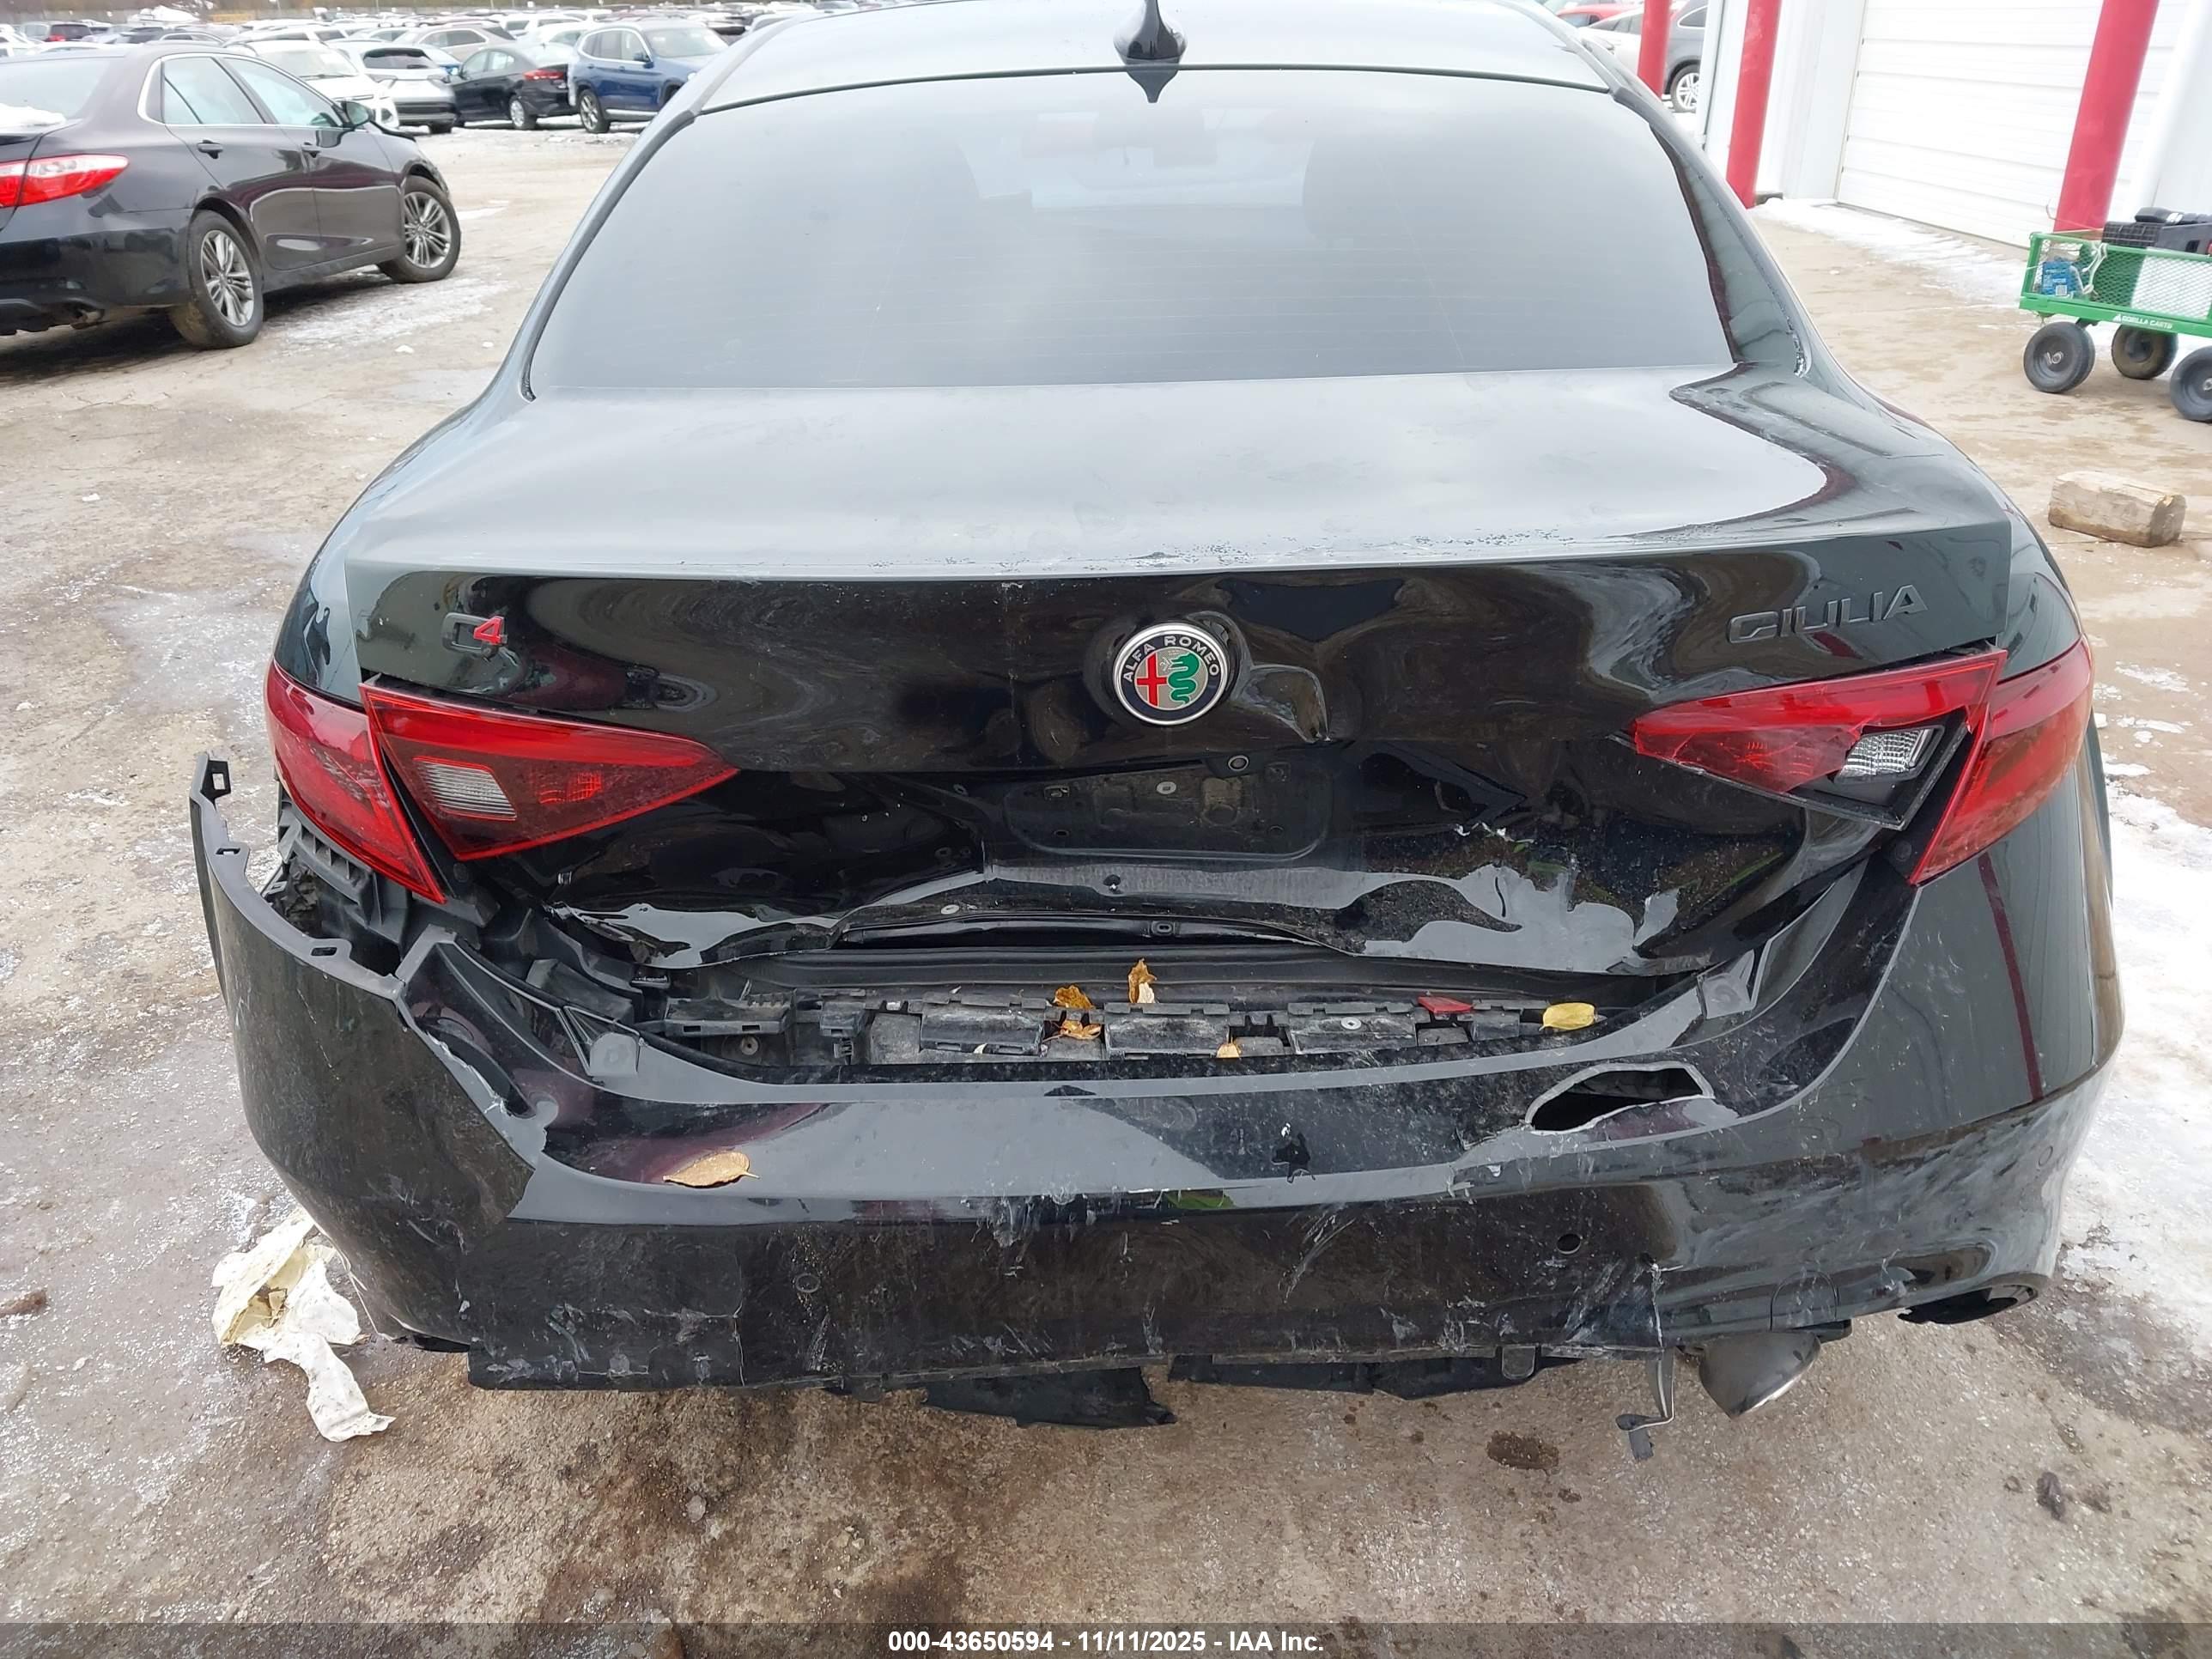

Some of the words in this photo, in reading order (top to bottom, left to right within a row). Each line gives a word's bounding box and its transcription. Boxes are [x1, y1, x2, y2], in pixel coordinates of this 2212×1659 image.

[1726, 584, 1929, 644] GIULIA
[1123, 642, 1156, 683] ALFA
[1164, 635, 1219, 677] ROMEO
